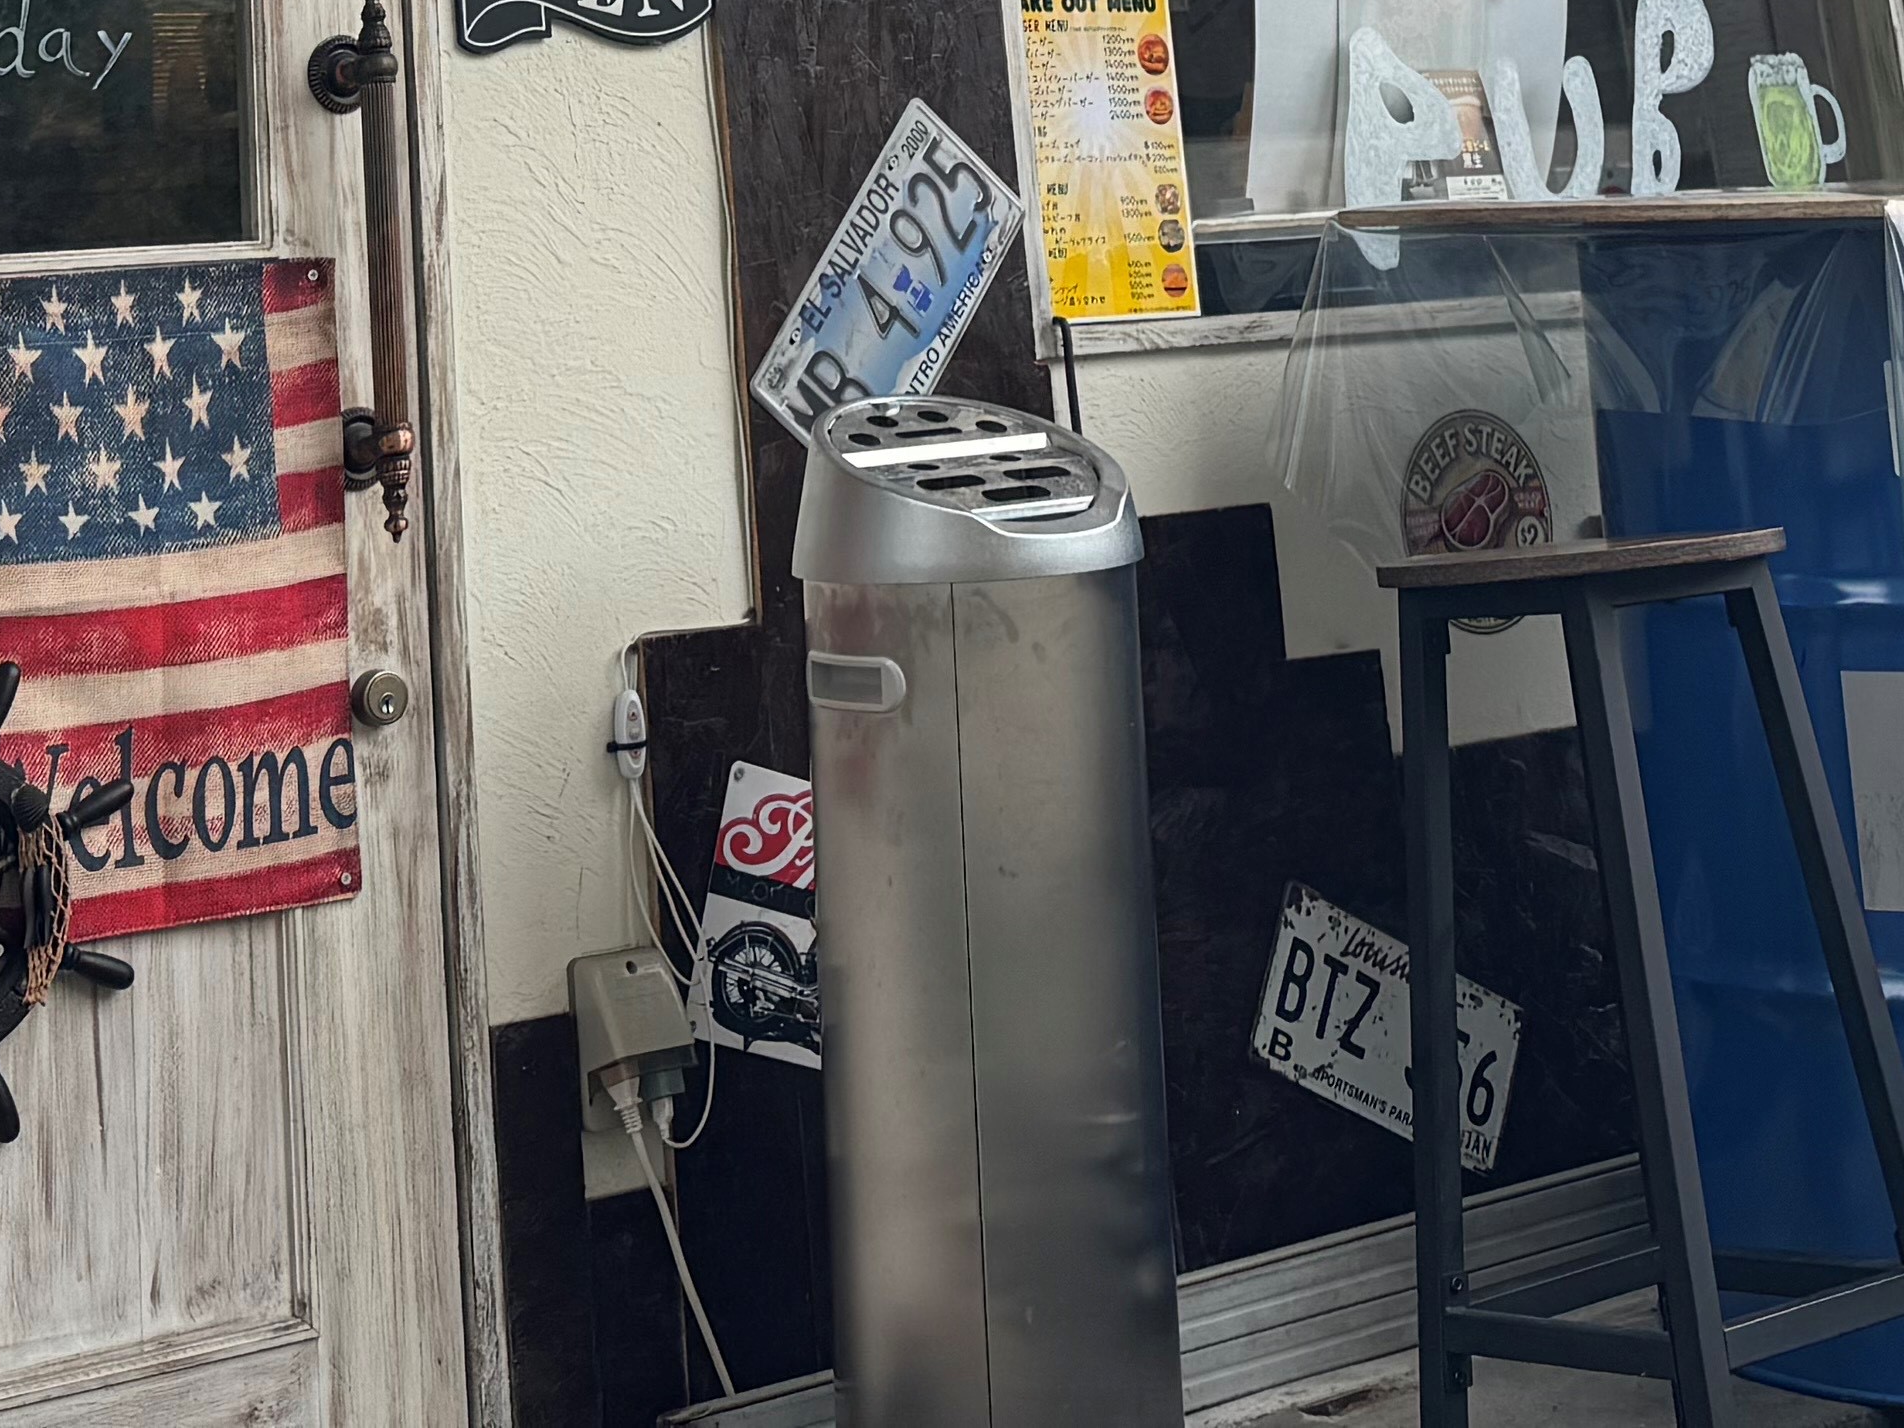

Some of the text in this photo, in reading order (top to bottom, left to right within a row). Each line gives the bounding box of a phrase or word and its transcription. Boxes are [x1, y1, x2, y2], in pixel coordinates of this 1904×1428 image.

[798, 119, 929, 334] EL SALVADOR 2000
[1408, 422, 1535, 504] BEEF STEAK
[1275, 935, 1381, 1061] BTZ
